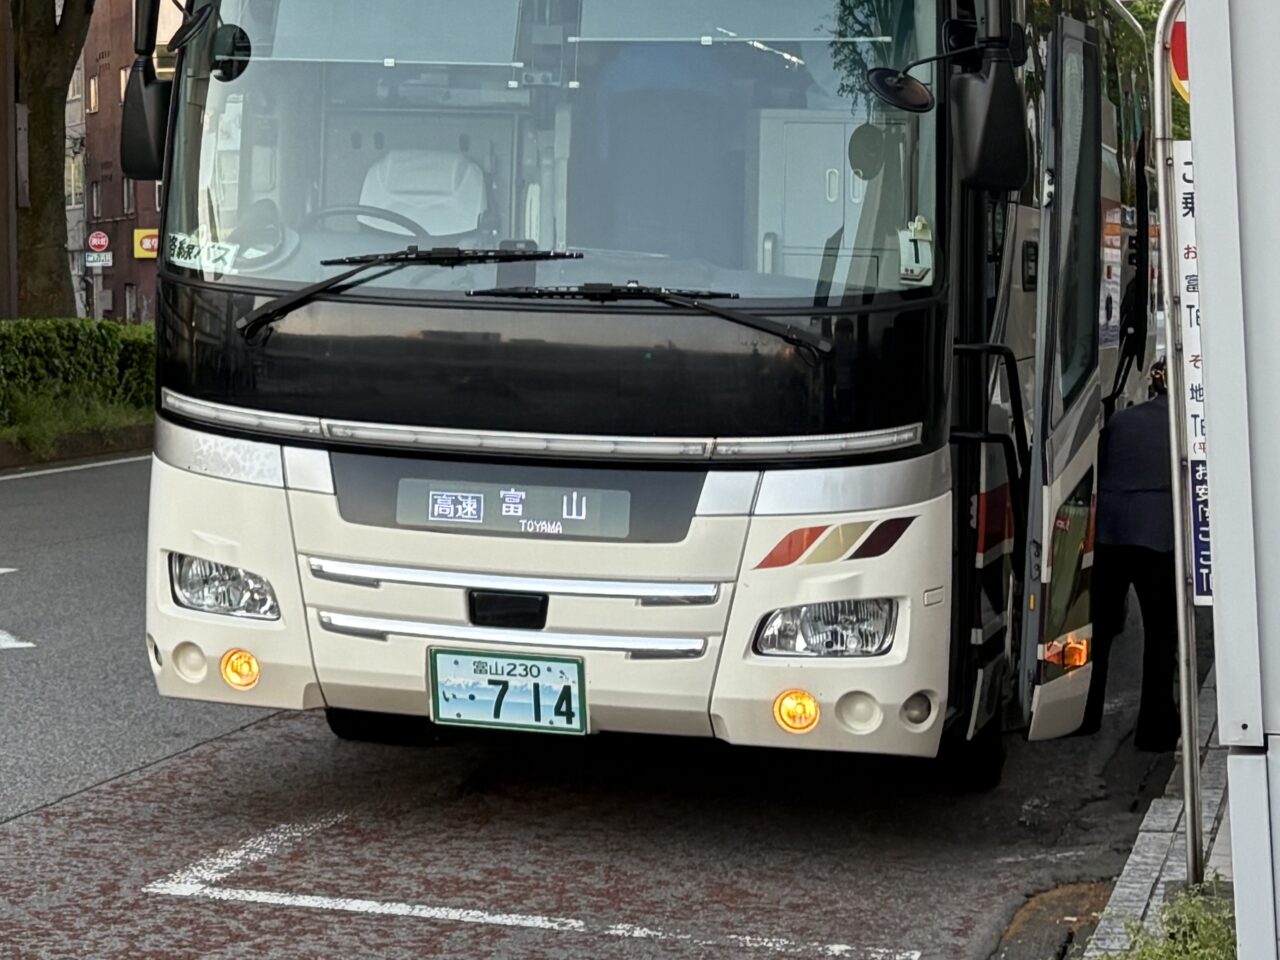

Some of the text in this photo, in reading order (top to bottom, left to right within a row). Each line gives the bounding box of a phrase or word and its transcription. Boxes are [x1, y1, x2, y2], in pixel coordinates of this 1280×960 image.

[433, 493, 479, 519] 高速
[519, 519, 563, 535] TOYAMA
[472, 660, 541, 679] 富山230
